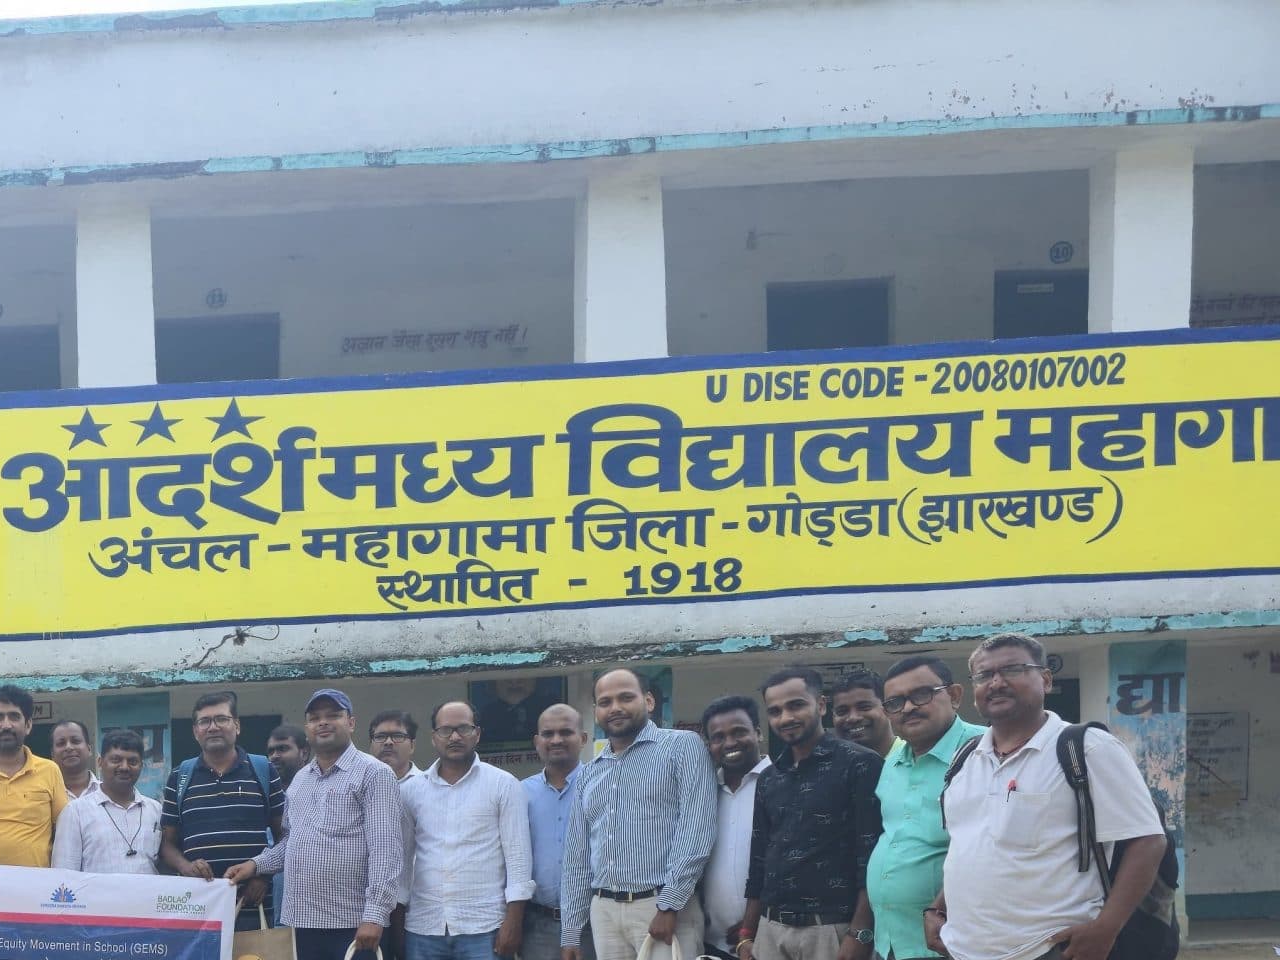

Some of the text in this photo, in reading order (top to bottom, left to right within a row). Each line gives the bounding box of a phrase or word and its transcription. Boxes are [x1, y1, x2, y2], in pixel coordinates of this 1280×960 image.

[707, 375, 727, 403] U
[742, 368, 810, 402] DISE
[818, 365, 904, 399] CODE
[556, 403, 984, 497] विद्यालय
[376, 559, 539, 611] स्थापित
[623, 558, 744, 597] 1918
[156, 903, 206, 912] FOUNDATION
[157, 895, 187, 904] BADLAO
[30, 938, 80, 951] Movement
[82, 941, 91, 951] in
[94, 941, 127, 953] School
[130, 943, 168, 956] (GEMS)
